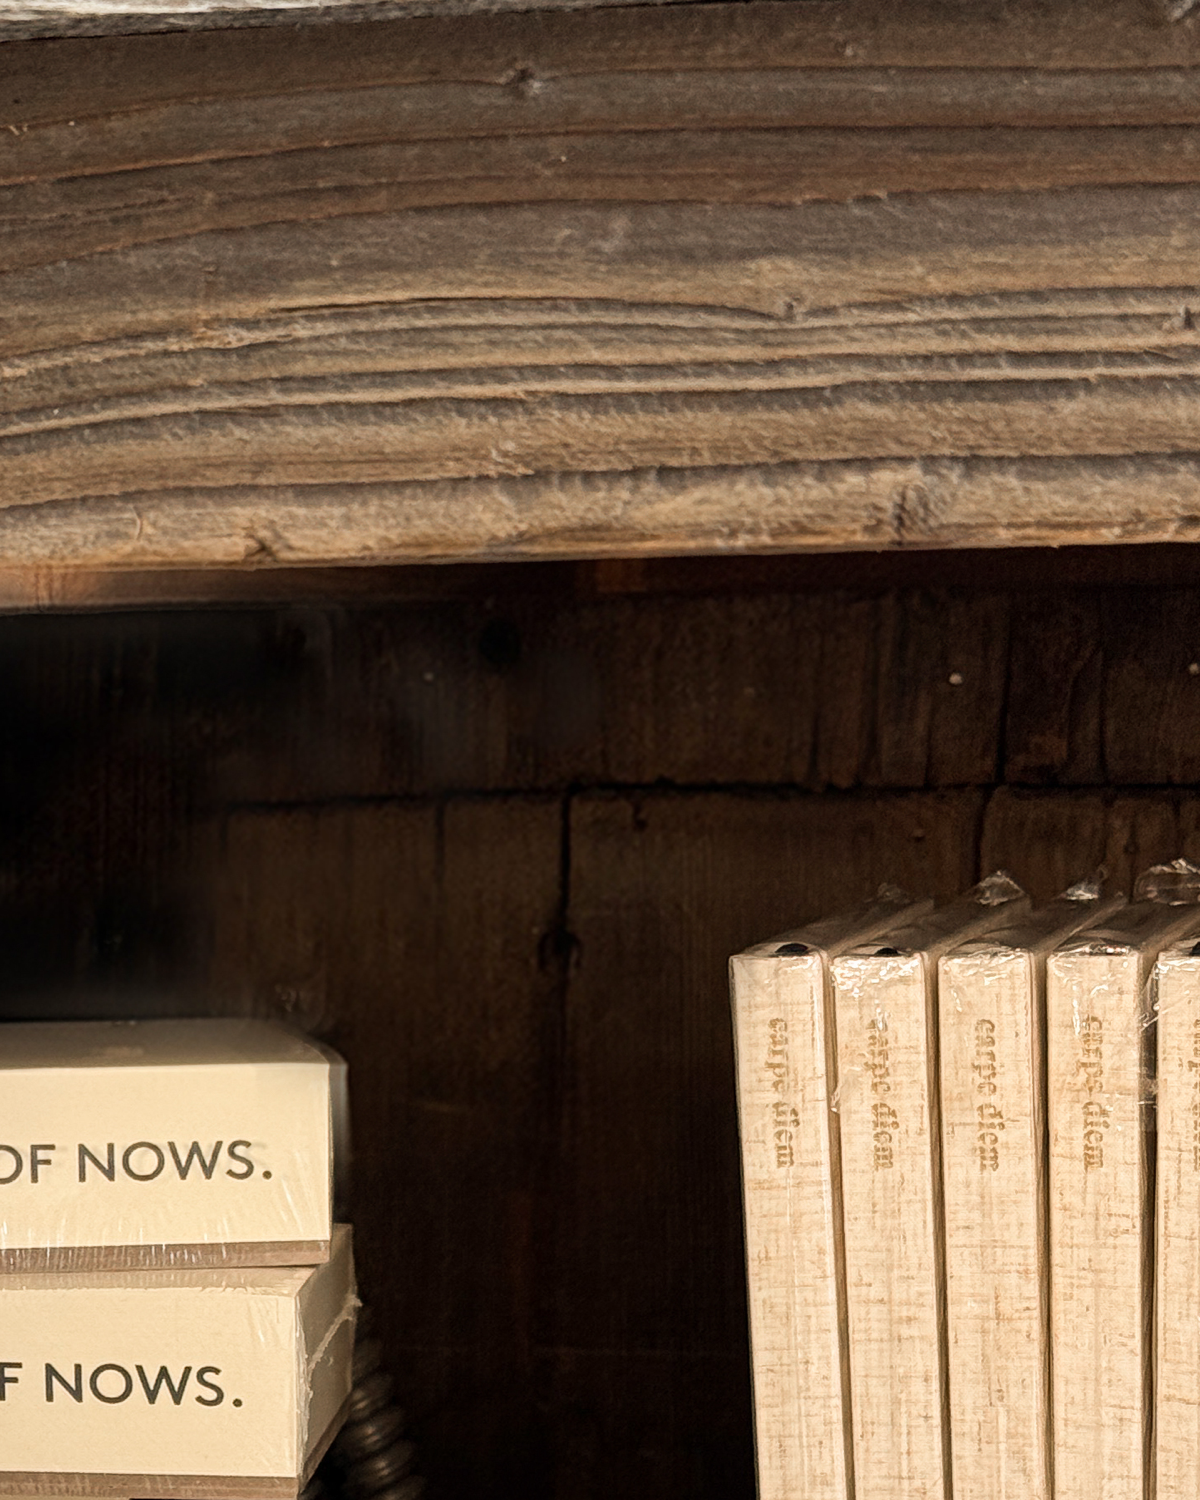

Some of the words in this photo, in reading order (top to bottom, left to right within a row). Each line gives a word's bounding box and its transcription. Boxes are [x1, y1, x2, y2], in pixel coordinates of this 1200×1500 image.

[764, 1017, 788, 1094] carpe
[971, 1018, 997, 1096] carpe
[77, 1138, 273, 1184] NOWS.
[772, 1100, 801, 1169] diem
[871, 1102, 899, 1171] diem
[976, 1102, 1006, 1172] diem
[1082, 1100, 1110, 1171] diem
[44, 1362, 243, 1408] NOWS.
